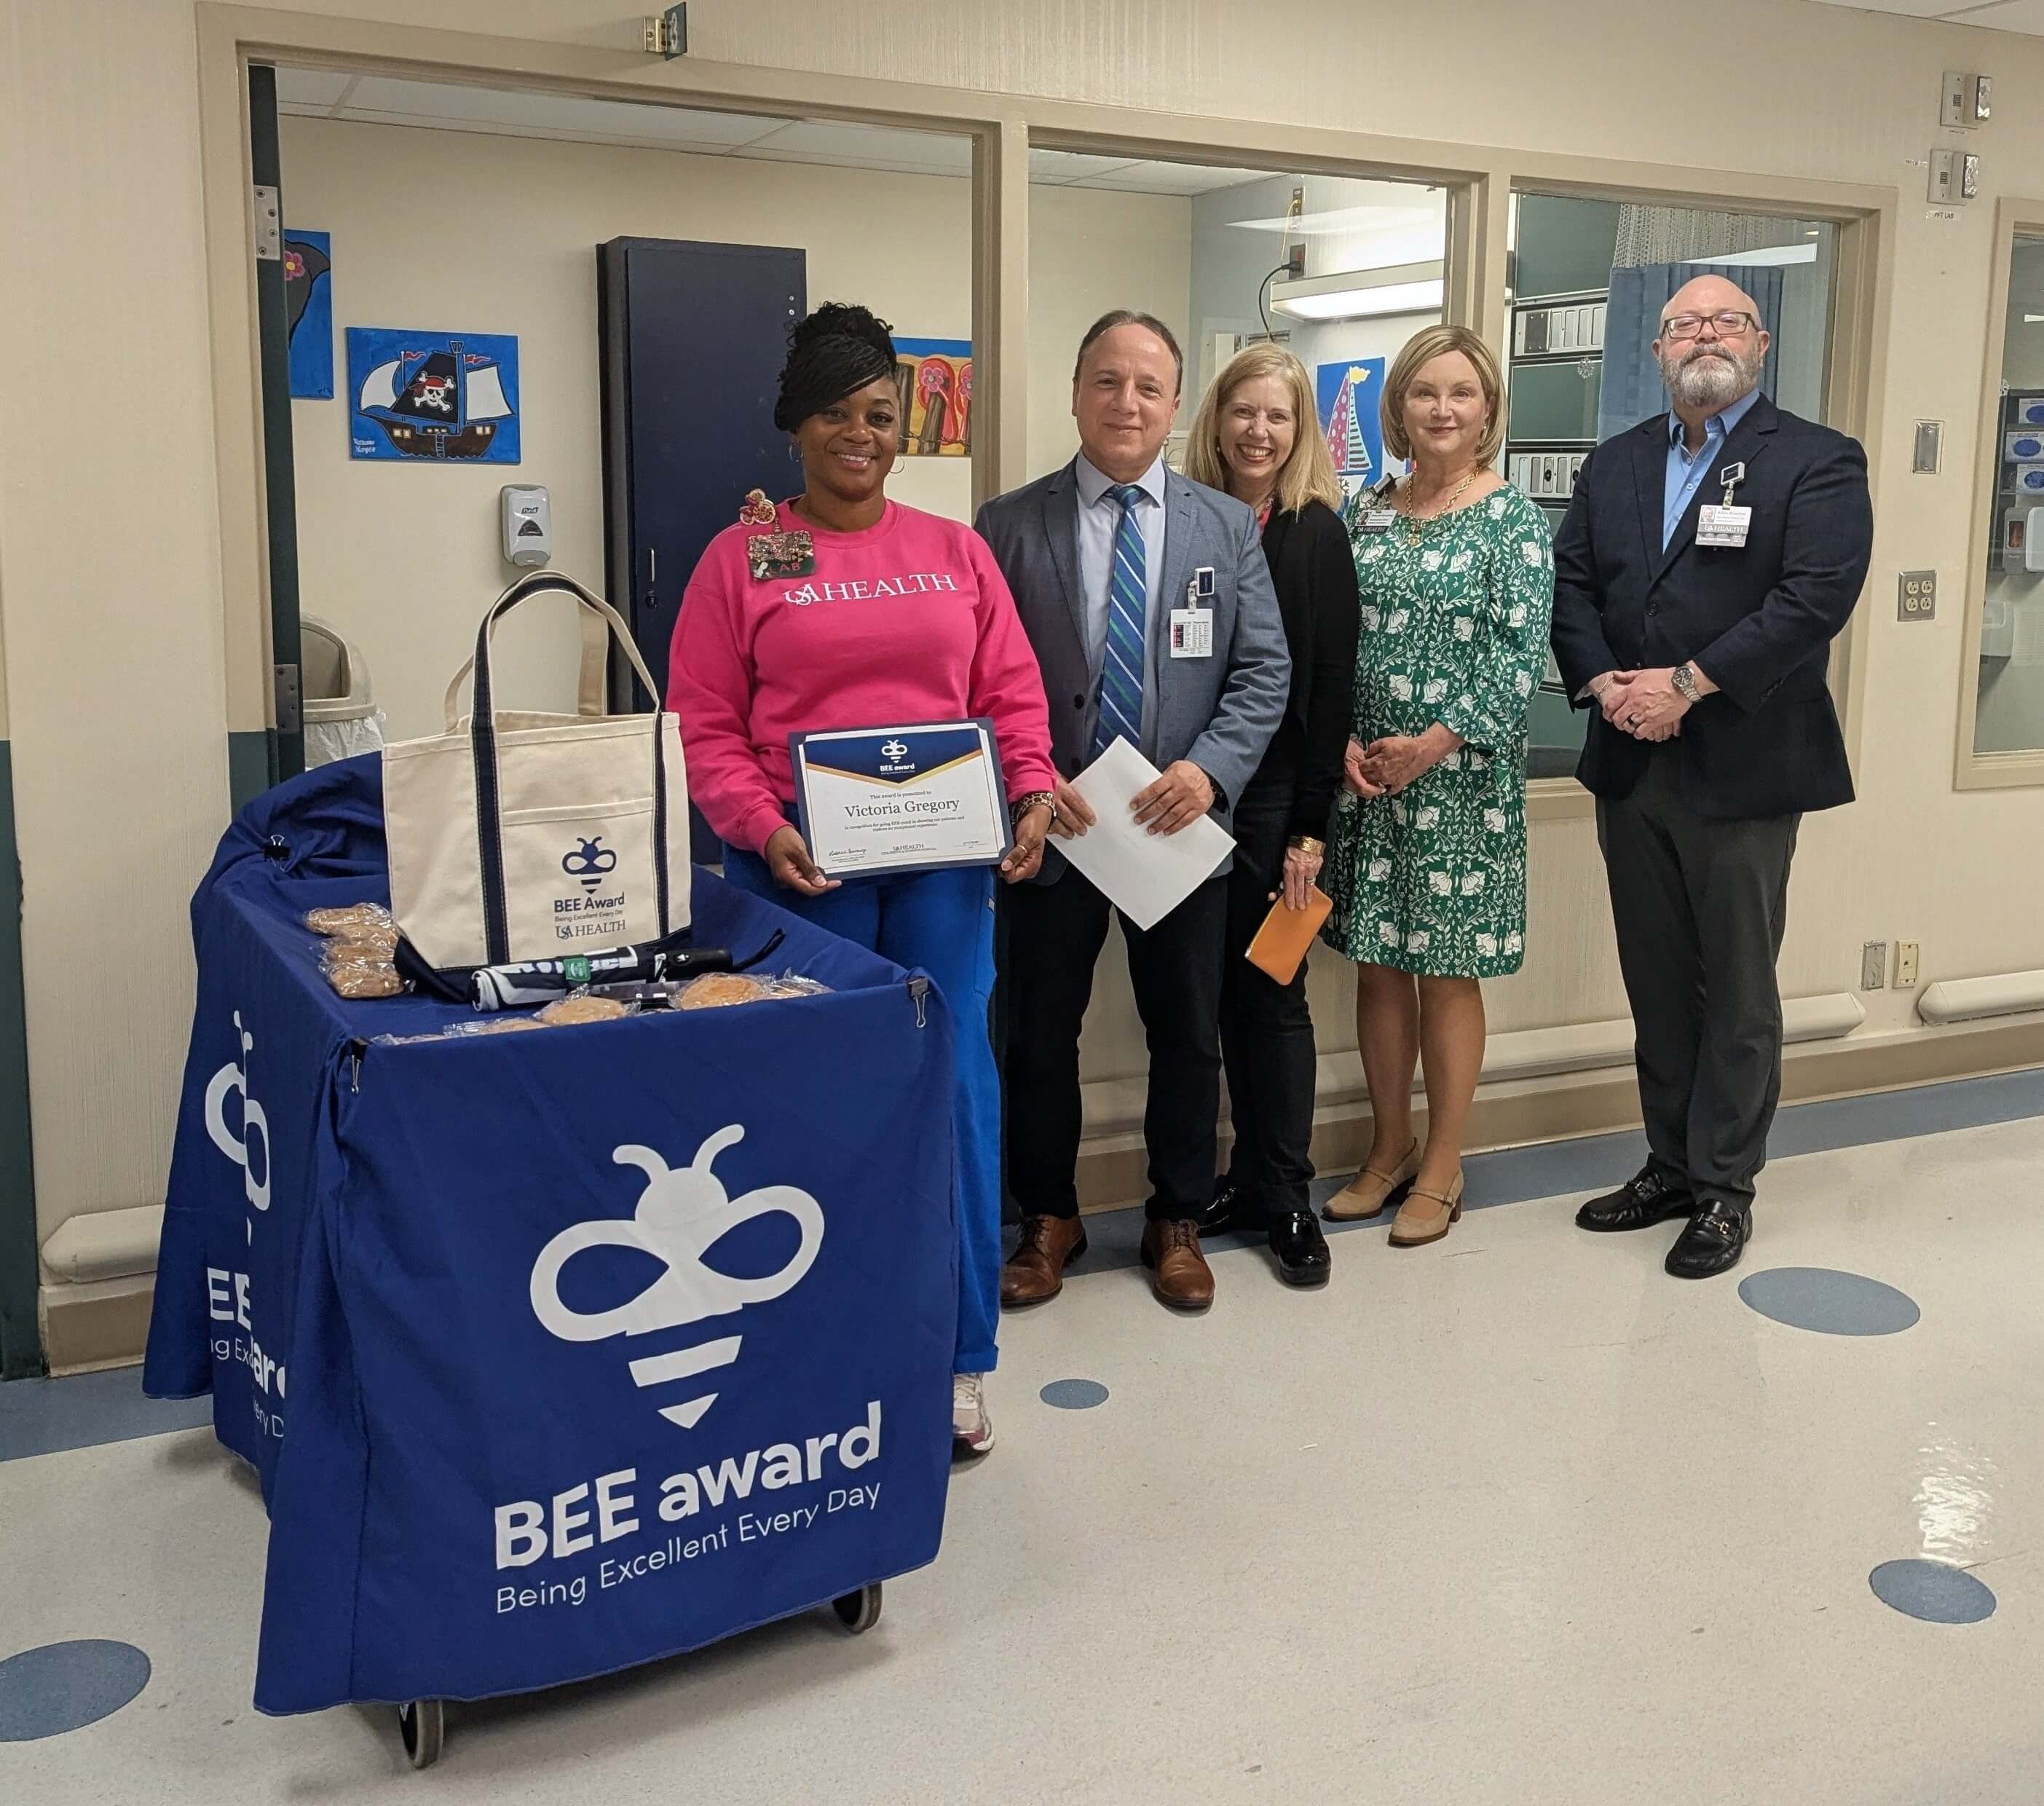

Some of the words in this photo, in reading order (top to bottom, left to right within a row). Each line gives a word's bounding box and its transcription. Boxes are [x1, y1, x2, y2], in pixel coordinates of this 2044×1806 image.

[770, 562, 801, 574] LAB
[821, 573, 958, 601] HEALTH
[845, 803, 901, 818] Victoria
[904, 800, 960, 813] Gregory
[554, 898, 581, 912] BEE
[583, 891, 625, 910] Award
[555, 915, 572, 923] Being
[573, 912, 598, 921] Excellent
[575, 919, 626, 937] HEALTH
[494, 1468, 640, 1570] BEE
[658, 1400, 881, 1522] award
[497, 1574, 587, 1613] Being
[600, 1523, 729, 1590] Excellent
[738, 1503, 819, 1542] Every
[826, 1483, 881, 1515] Day
